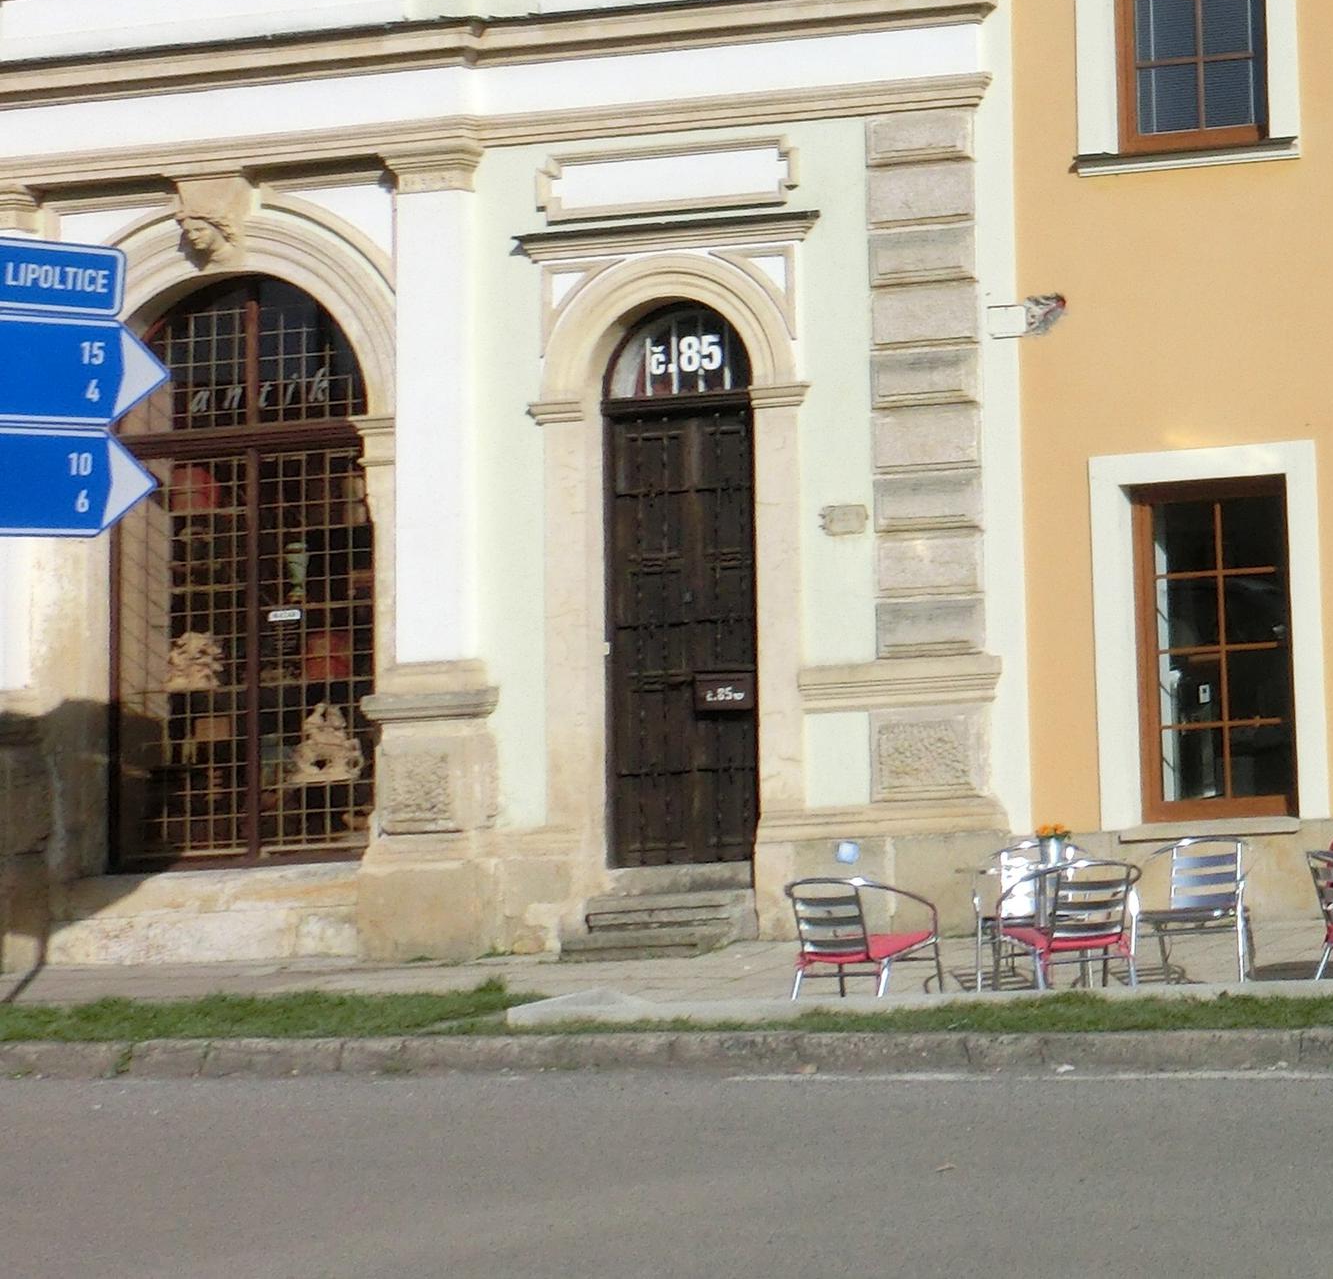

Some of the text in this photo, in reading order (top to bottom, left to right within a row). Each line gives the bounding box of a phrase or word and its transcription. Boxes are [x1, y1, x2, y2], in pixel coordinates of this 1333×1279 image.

[5, 261, 110, 293] LIPOLTICE
[80, 341, 105, 365] 15
[85, 378, 100, 402] 4
[191, 366, 330, 413] antik
[68, 452, 93, 476] 10
[75, 488, 90, 513] 6
